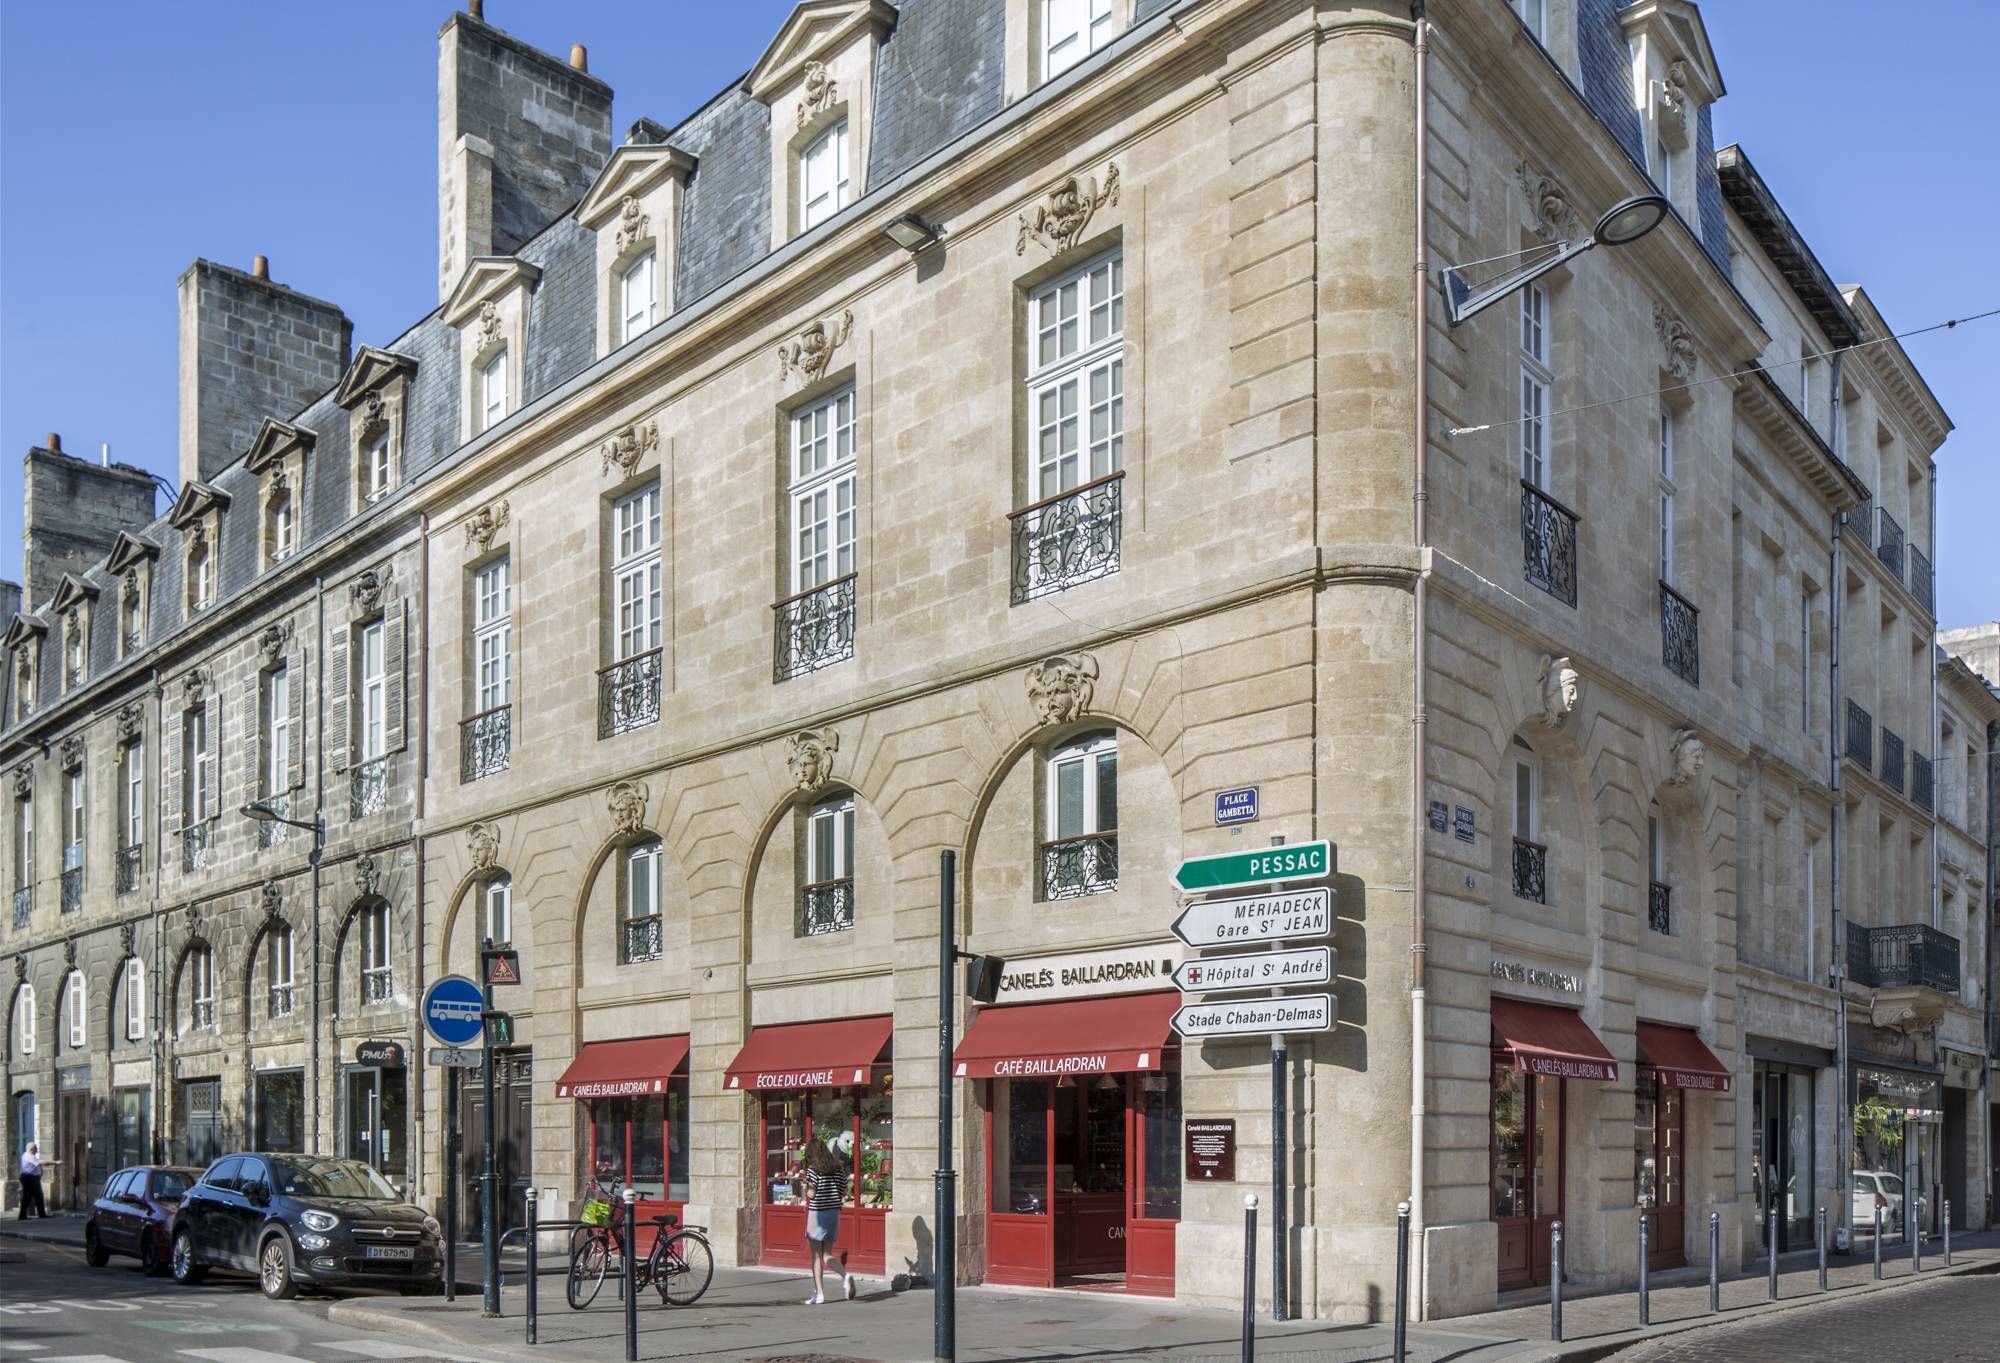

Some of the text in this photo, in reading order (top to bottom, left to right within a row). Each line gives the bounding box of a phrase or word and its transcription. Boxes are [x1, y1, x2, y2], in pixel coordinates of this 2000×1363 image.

[1224, 793, 1248, 805] PLACE
[1218, 805, 1254, 818] GAMBETTA
[1251, 851, 1320, 876] PESSAC
[1235, 897, 1322, 919] MÉRIADECK
[1217, 925, 1249, 937] Gare
[1284, 915, 1323, 931] JEAN
[1000, 960, 1155, 991] CANELÉS BAILLARDRAN
[1206, 959, 1323, 983] Hôpital St André
[1188, 1008, 1322, 1027] Stade Chaban-Delmas
[994, 1056, 1106, 1075] CAFÉ BAILLARDRAN
[1531, 1058, 1603, 1079] CANELÉS BAILLARDRAN
[573, 1081, 648, 1096] CANELÉS BAILLARDRAN
[756, 1070, 833, 1088] ÉCOLE DU CANELÉ
[1676, 1072, 1716, 1089] ÉCOLE DU CANELÉ
